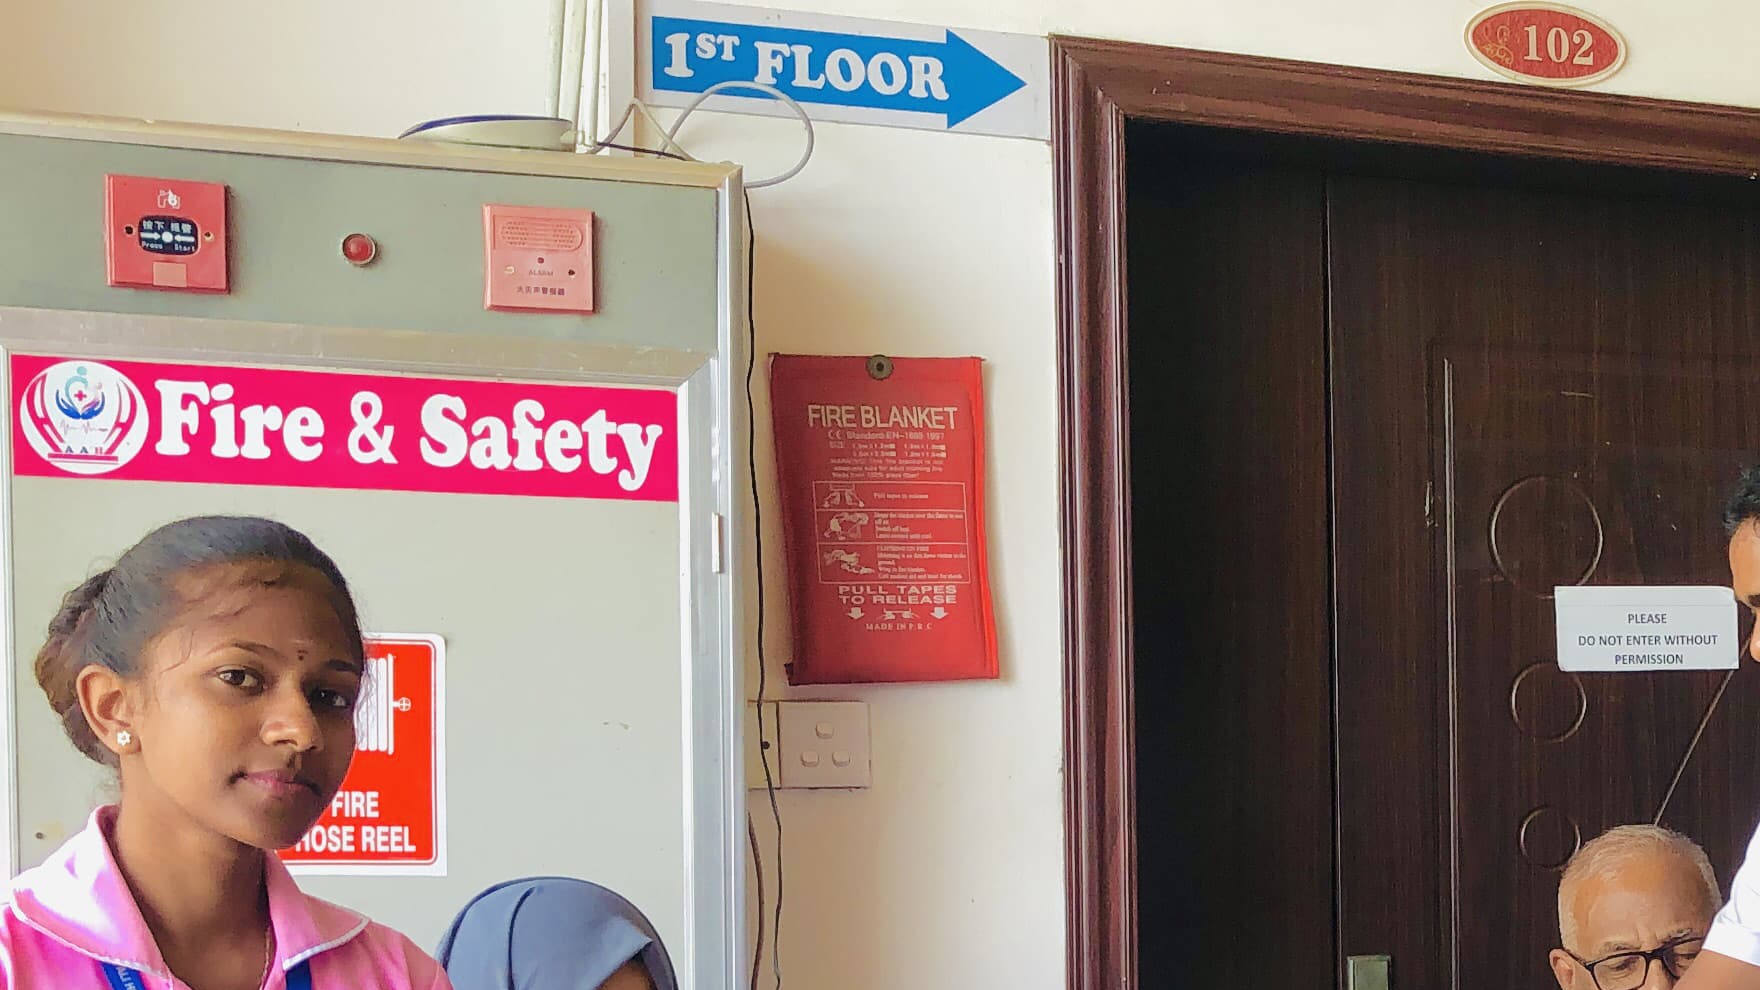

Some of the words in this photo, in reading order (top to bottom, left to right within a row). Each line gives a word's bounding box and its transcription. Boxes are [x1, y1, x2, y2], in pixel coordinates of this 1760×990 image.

[1524, 25, 1593, 66] 102
[664, 33, 740, 78] 1ST
[754, 41, 950, 100] FLOOR
[174, 243, 195, 252] Start
[807, 404, 857, 428] FIRE
[860, 406, 958, 429] BLANKET
[154, 379, 325, 463] Fire
[348, 391, 398, 466] &
[419, 394, 663, 492] Safety
[838, 585, 888, 595] PULL
[896, 585, 957, 594] TAPES
[839, 595, 865, 604] TO
[872, 595, 957, 604] RELEASE
[1627, 613, 1667, 624] PLEASE
[866, 623, 893, 631] MADE
[896, 623, 906, 631] IN
[1578, 636, 1595, 646] DO
[1599, 636, 1622, 646] NOT
[1626, 635, 1661, 645] ENTER
[1664, 634, 1718, 645] WITHOUT
[1615, 654, 1684, 665] PERMISSION
[331, 791, 379, 818] FIRE
[361, 826, 416, 852] REEL
